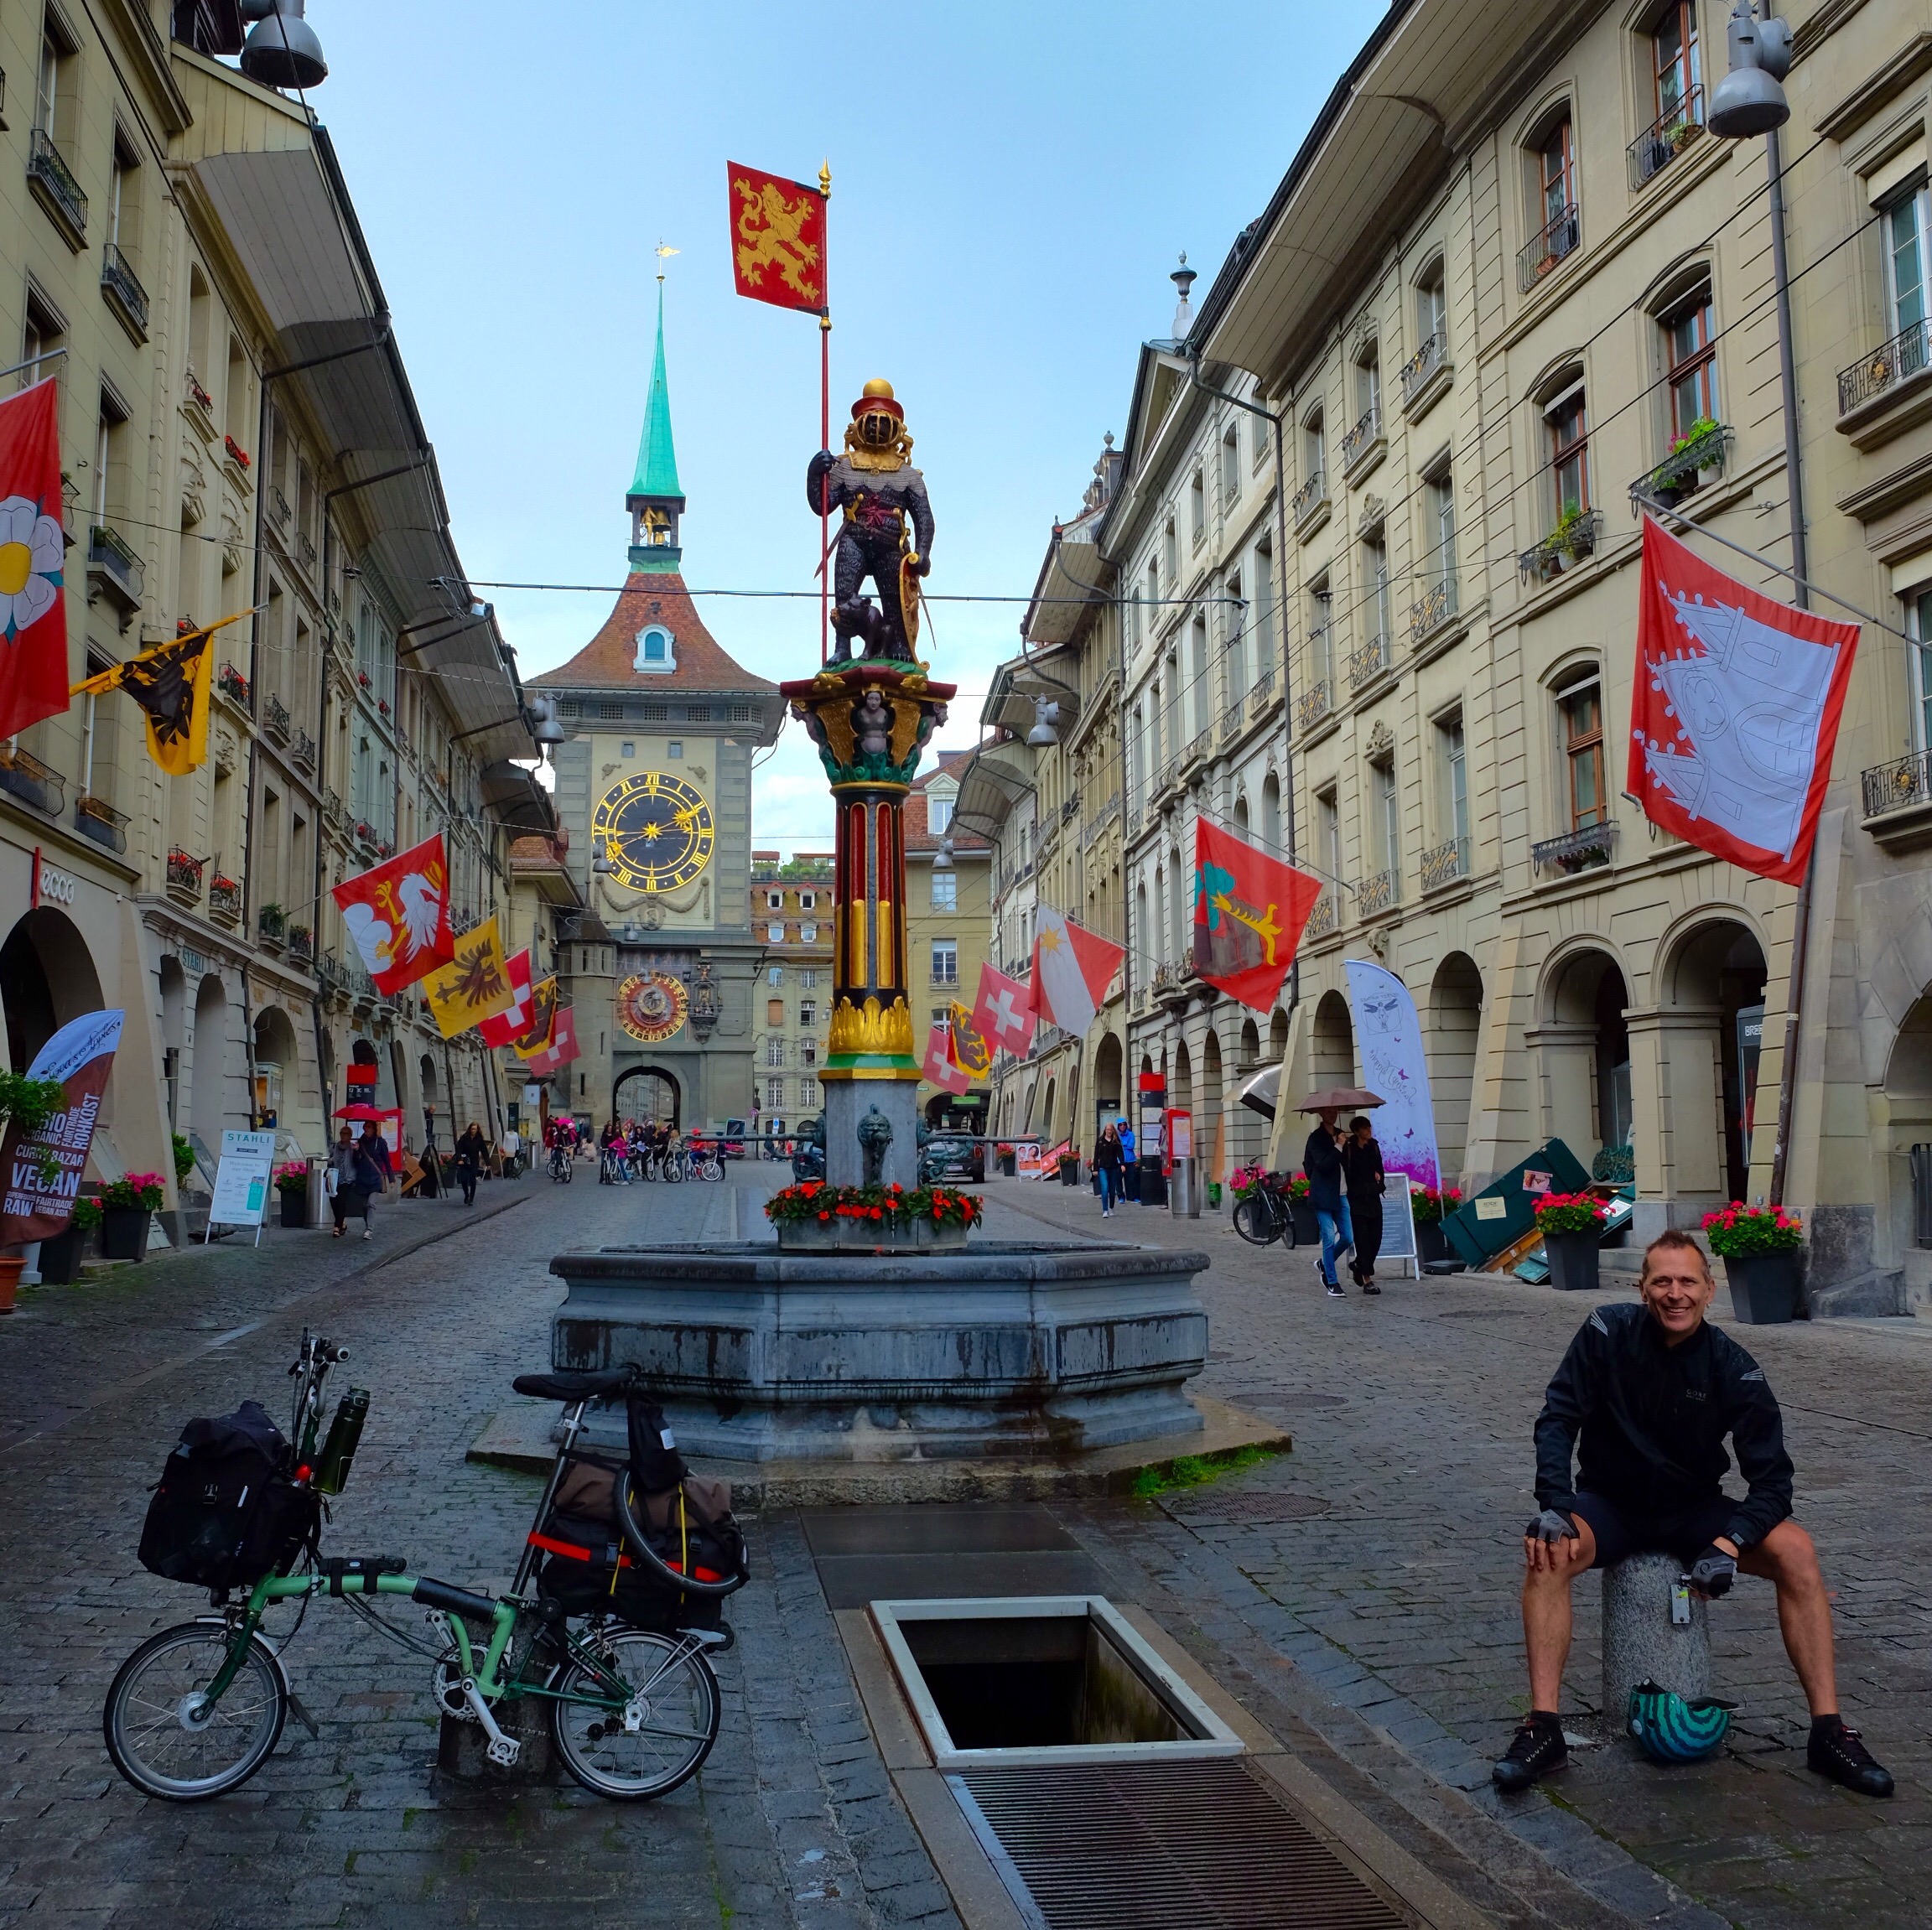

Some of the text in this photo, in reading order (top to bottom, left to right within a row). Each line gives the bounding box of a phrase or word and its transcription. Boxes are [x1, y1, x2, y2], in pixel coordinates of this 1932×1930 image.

[646, 774, 659, 785] XII
[621, 781, 633, 795] XI
[602, 800, 612, 812] X
[594, 823, 605, 835] IX
[701, 828, 713, 838] III
[691, 852, 707, 867] IIII
[43, 869, 75, 905] ecco
[61, 1107, 80, 1147] FAIRTRADE
[71, 1092, 101, 1150] ROHKOST
[15, 1144, 84, 1167] CUR BAZAR
[3, 1198, 34, 1217] RAW
[35, 1196, 74, 1210] FAIRTRADE
[35, 1206, 68, 1217] VEGAN ASIA
